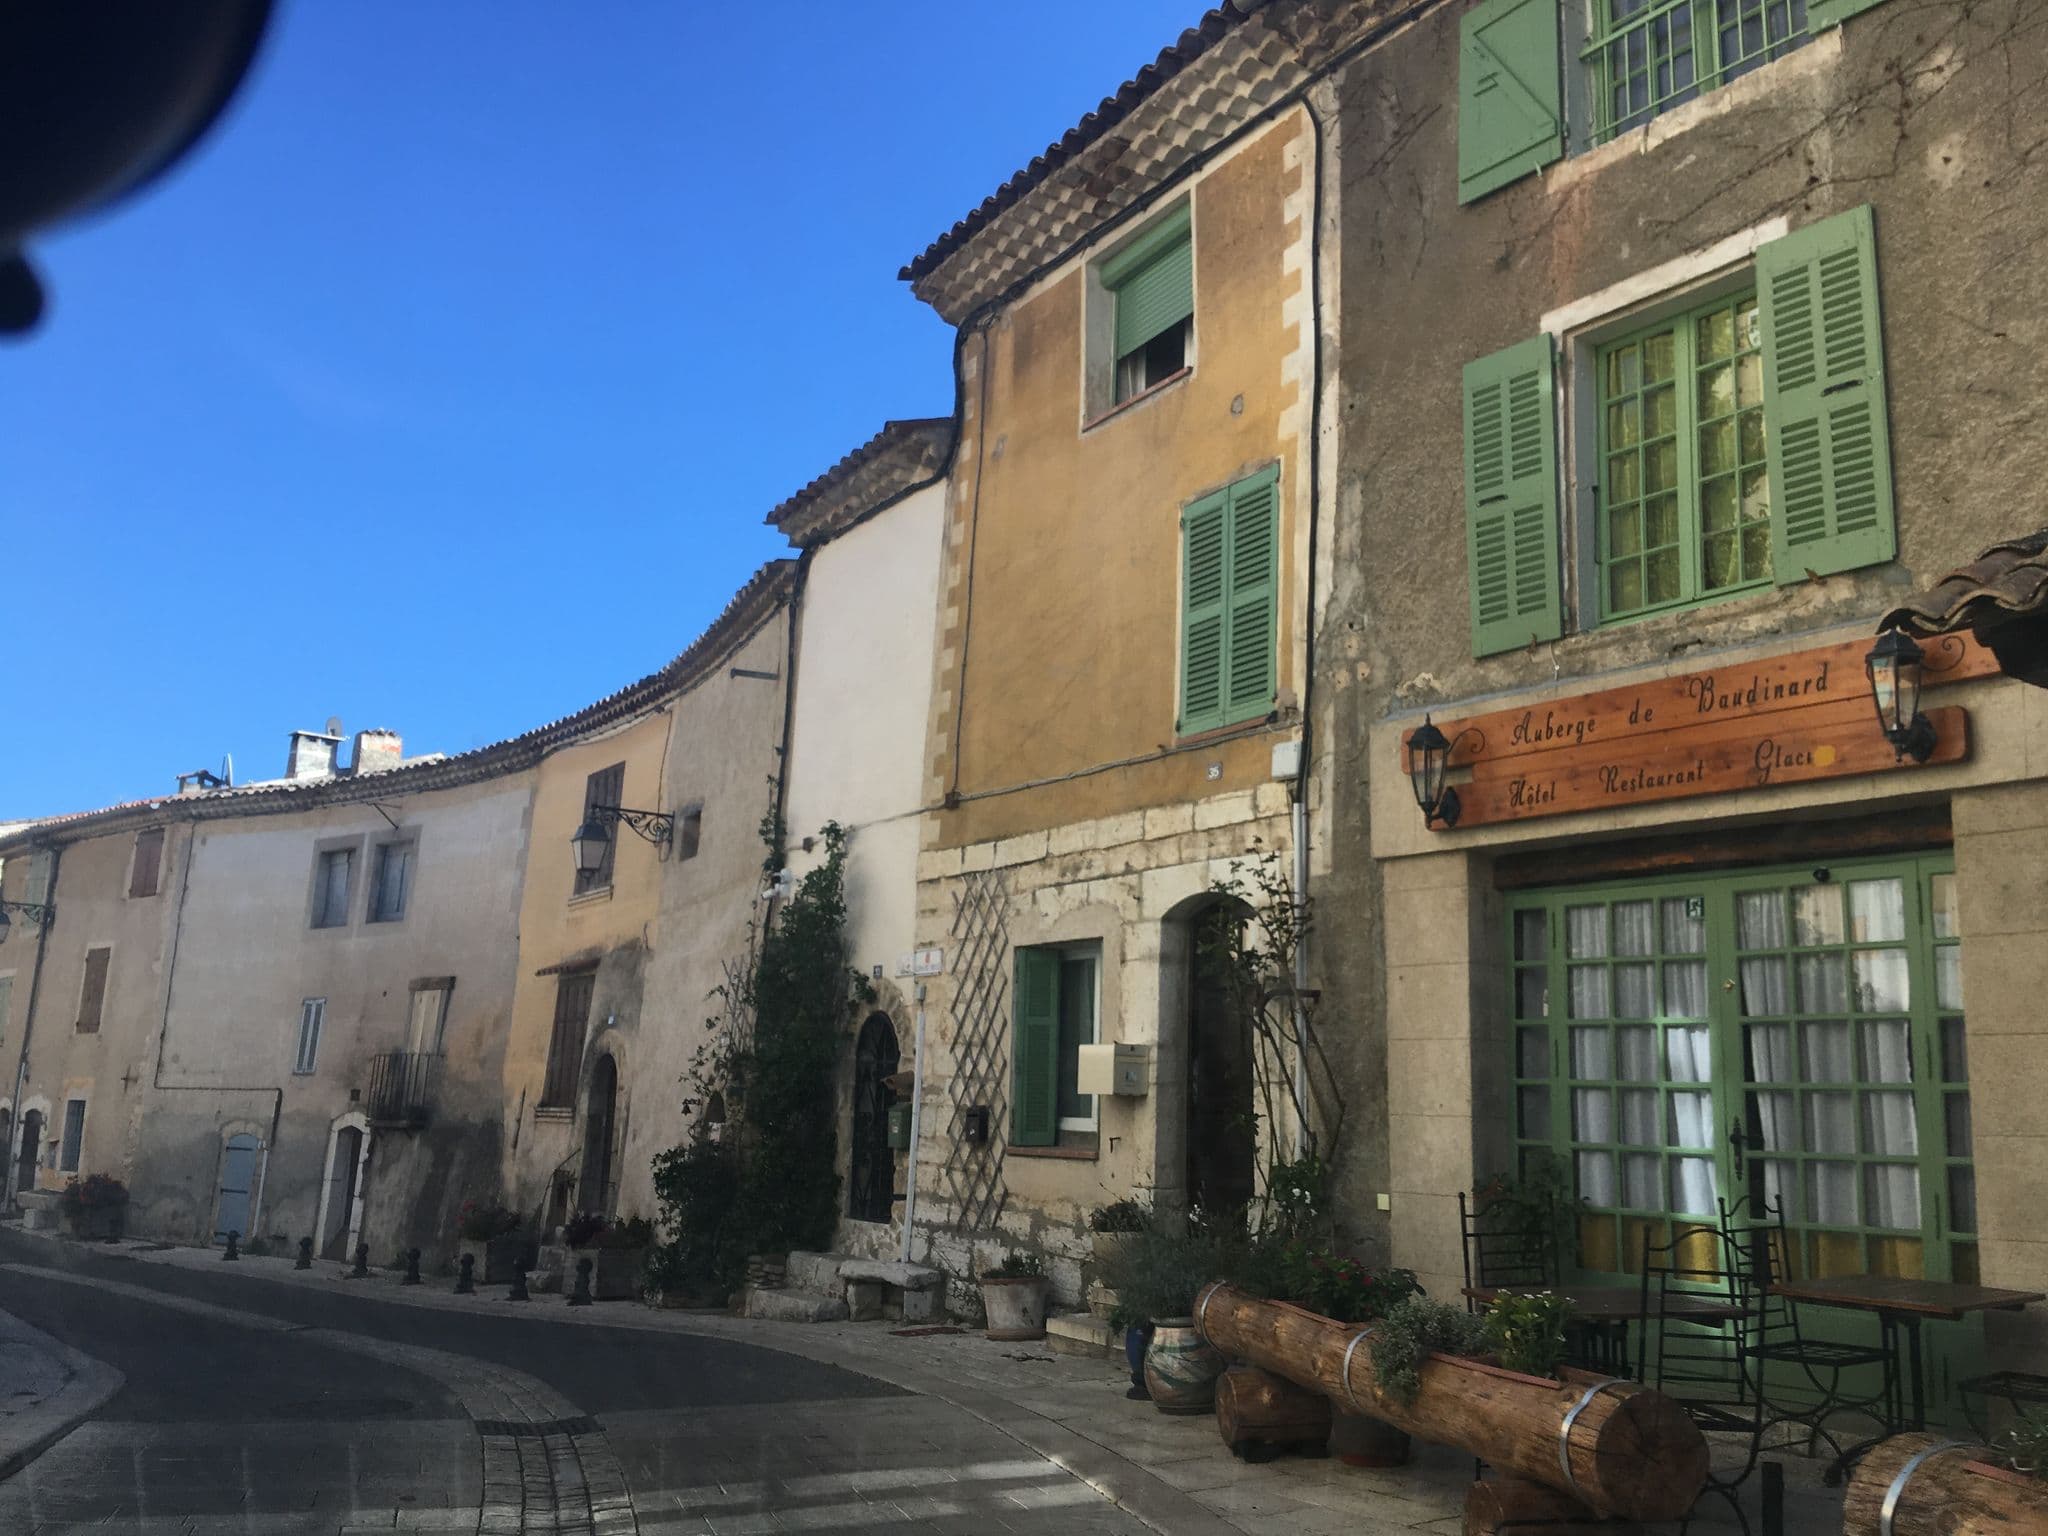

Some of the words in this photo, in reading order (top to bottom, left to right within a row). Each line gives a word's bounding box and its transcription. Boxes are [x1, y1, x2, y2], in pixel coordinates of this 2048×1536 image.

[1511, 711, 1596, 746] Auberge
[1629, 698, 1653, 725] de
[1689, 661, 1829, 713] Baudinard
[1509, 779, 1556, 808] Hôtel
[1599, 759, 1704, 794] Restaurant
[1755, 738, 1813, 784] Glaci
